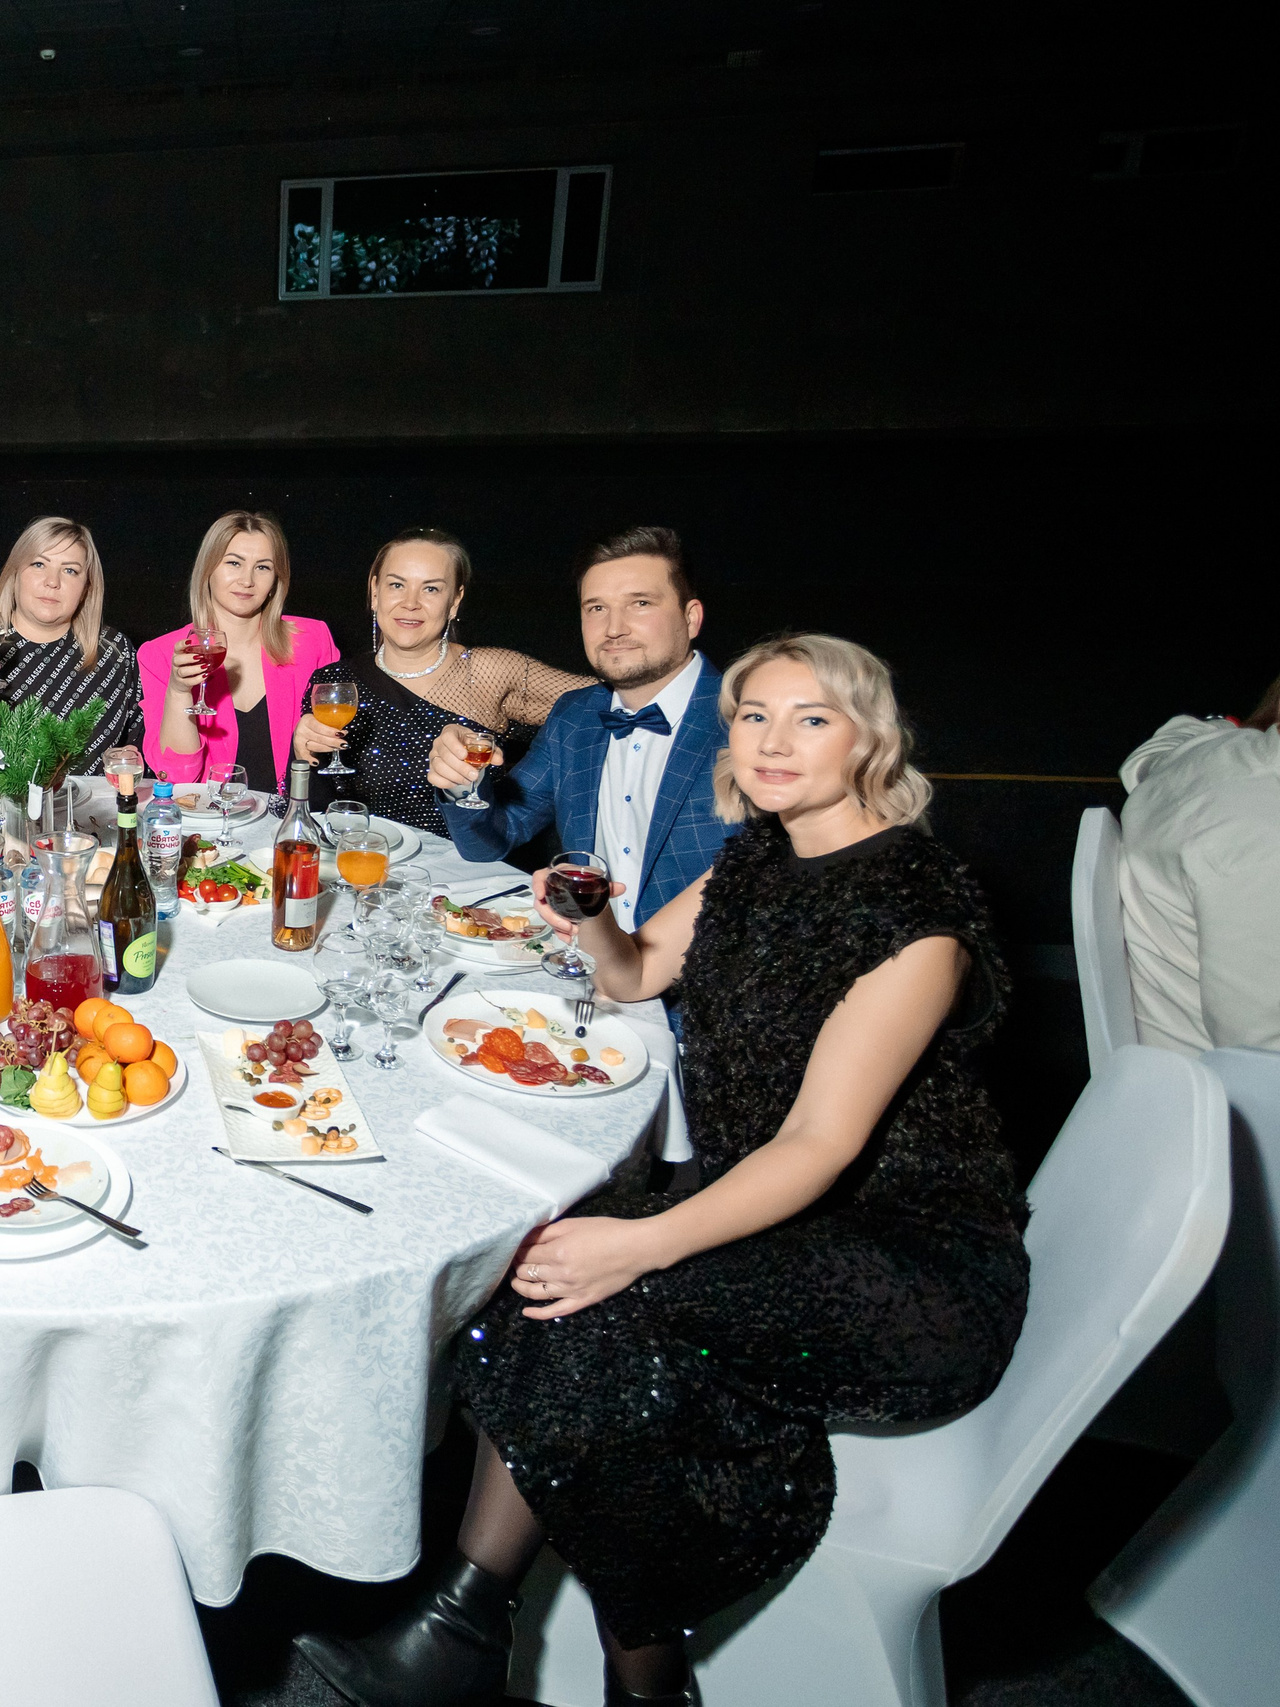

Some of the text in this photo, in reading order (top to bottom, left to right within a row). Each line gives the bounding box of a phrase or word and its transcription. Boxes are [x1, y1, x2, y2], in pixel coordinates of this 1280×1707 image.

[5, 667, 21, 683] ASCER
[25, 662, 47, 685] BEASCER
[50, 654, 71, 679] BEASCER
[52, 675, 73, 702] BEASCER
[56, 698, 76, 721] EASCER
[84, 734, 106, 757] EASCER
[82, 756, 103, 776] EASCER
